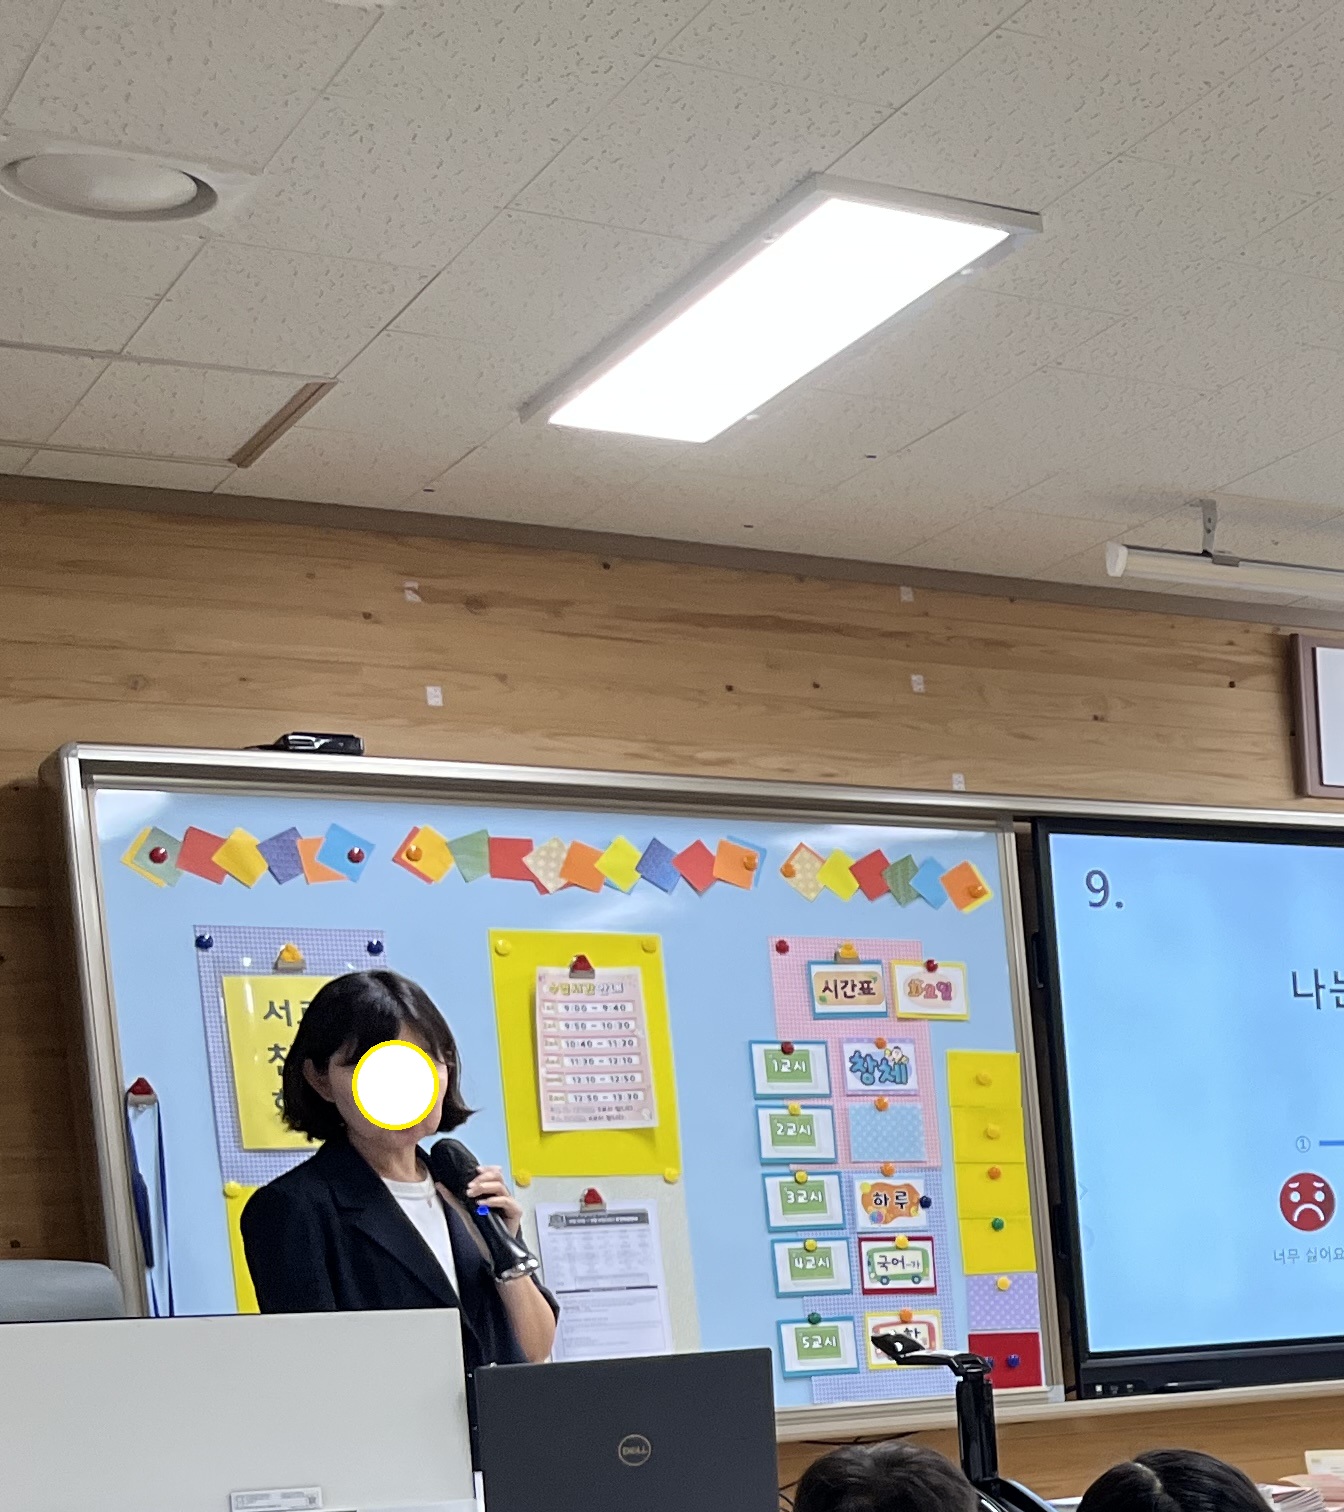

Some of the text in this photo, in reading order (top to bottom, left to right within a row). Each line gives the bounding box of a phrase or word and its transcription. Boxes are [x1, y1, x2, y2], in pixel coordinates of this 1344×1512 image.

[1086, 869, 1124, 909] 9.
[822, 979, 876, 1000] 시간표
[563, 1004, 588, 1012] 9:00
[771, 1049, 909, 1086] 1교시 창체
[776, 1122, 812, 1136] 2교시
[786, 1189, 823, 1204] 3교시
[794, 1256, 831, 1270] 4교시
[1273, 1247, 1300, 1264] 너무
[802, 1335, 838, 1349] 5교시
